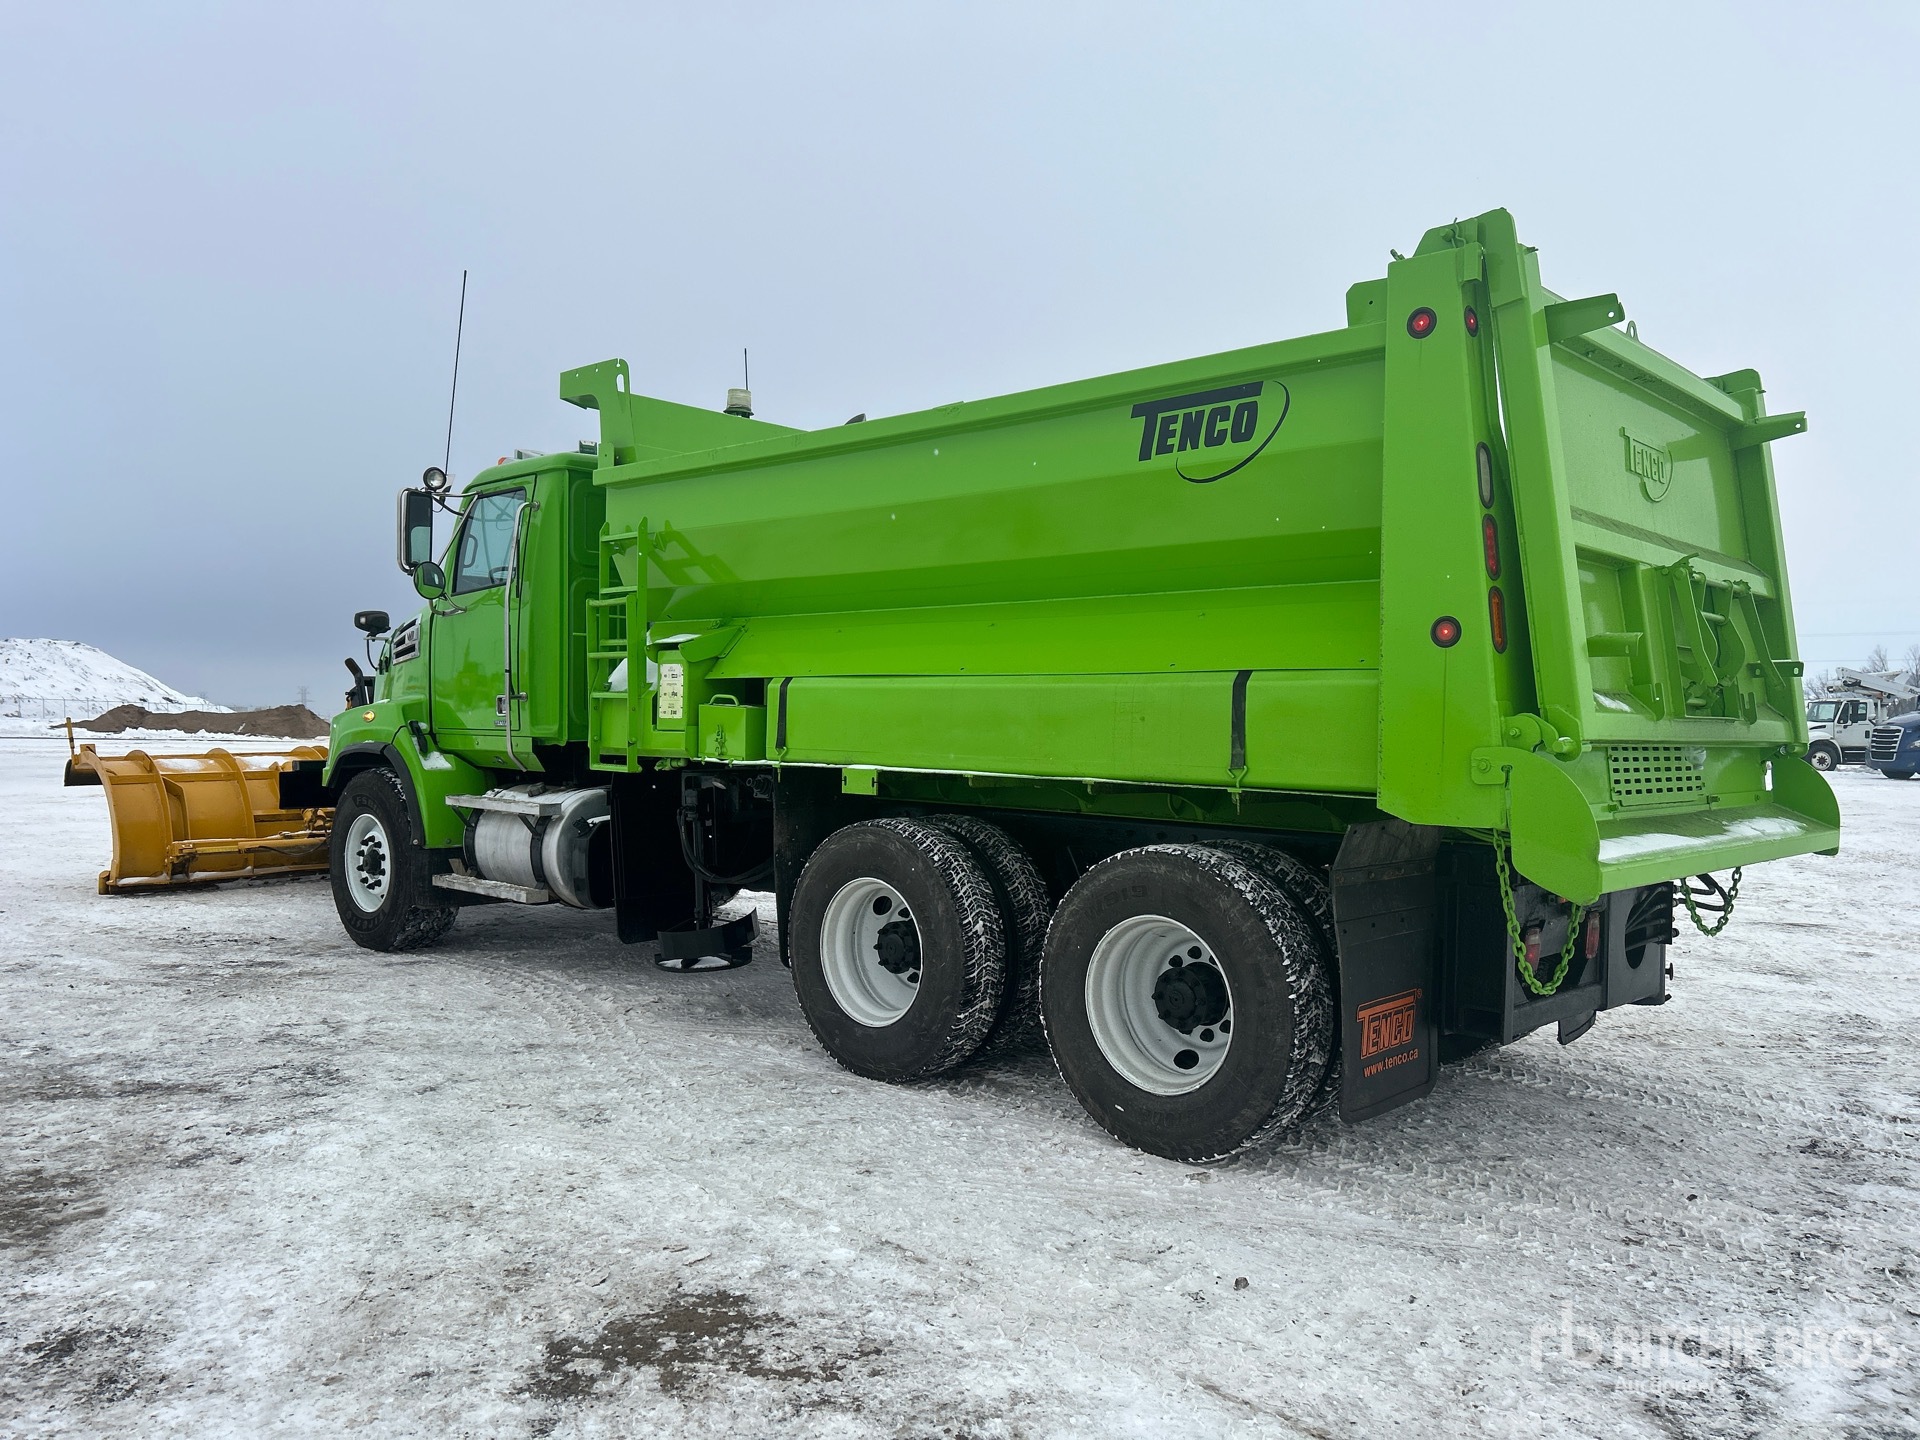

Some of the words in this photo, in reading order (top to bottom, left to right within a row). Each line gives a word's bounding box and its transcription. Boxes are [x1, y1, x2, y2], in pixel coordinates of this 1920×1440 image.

[1130, 381, 1264, 462] TENCO
[1619, 426, 1668, 485] TENCO
[1357, 989, 1416, 1059] TENCO
[1363, 1048, 1419, 1078] www.tenco.ca
